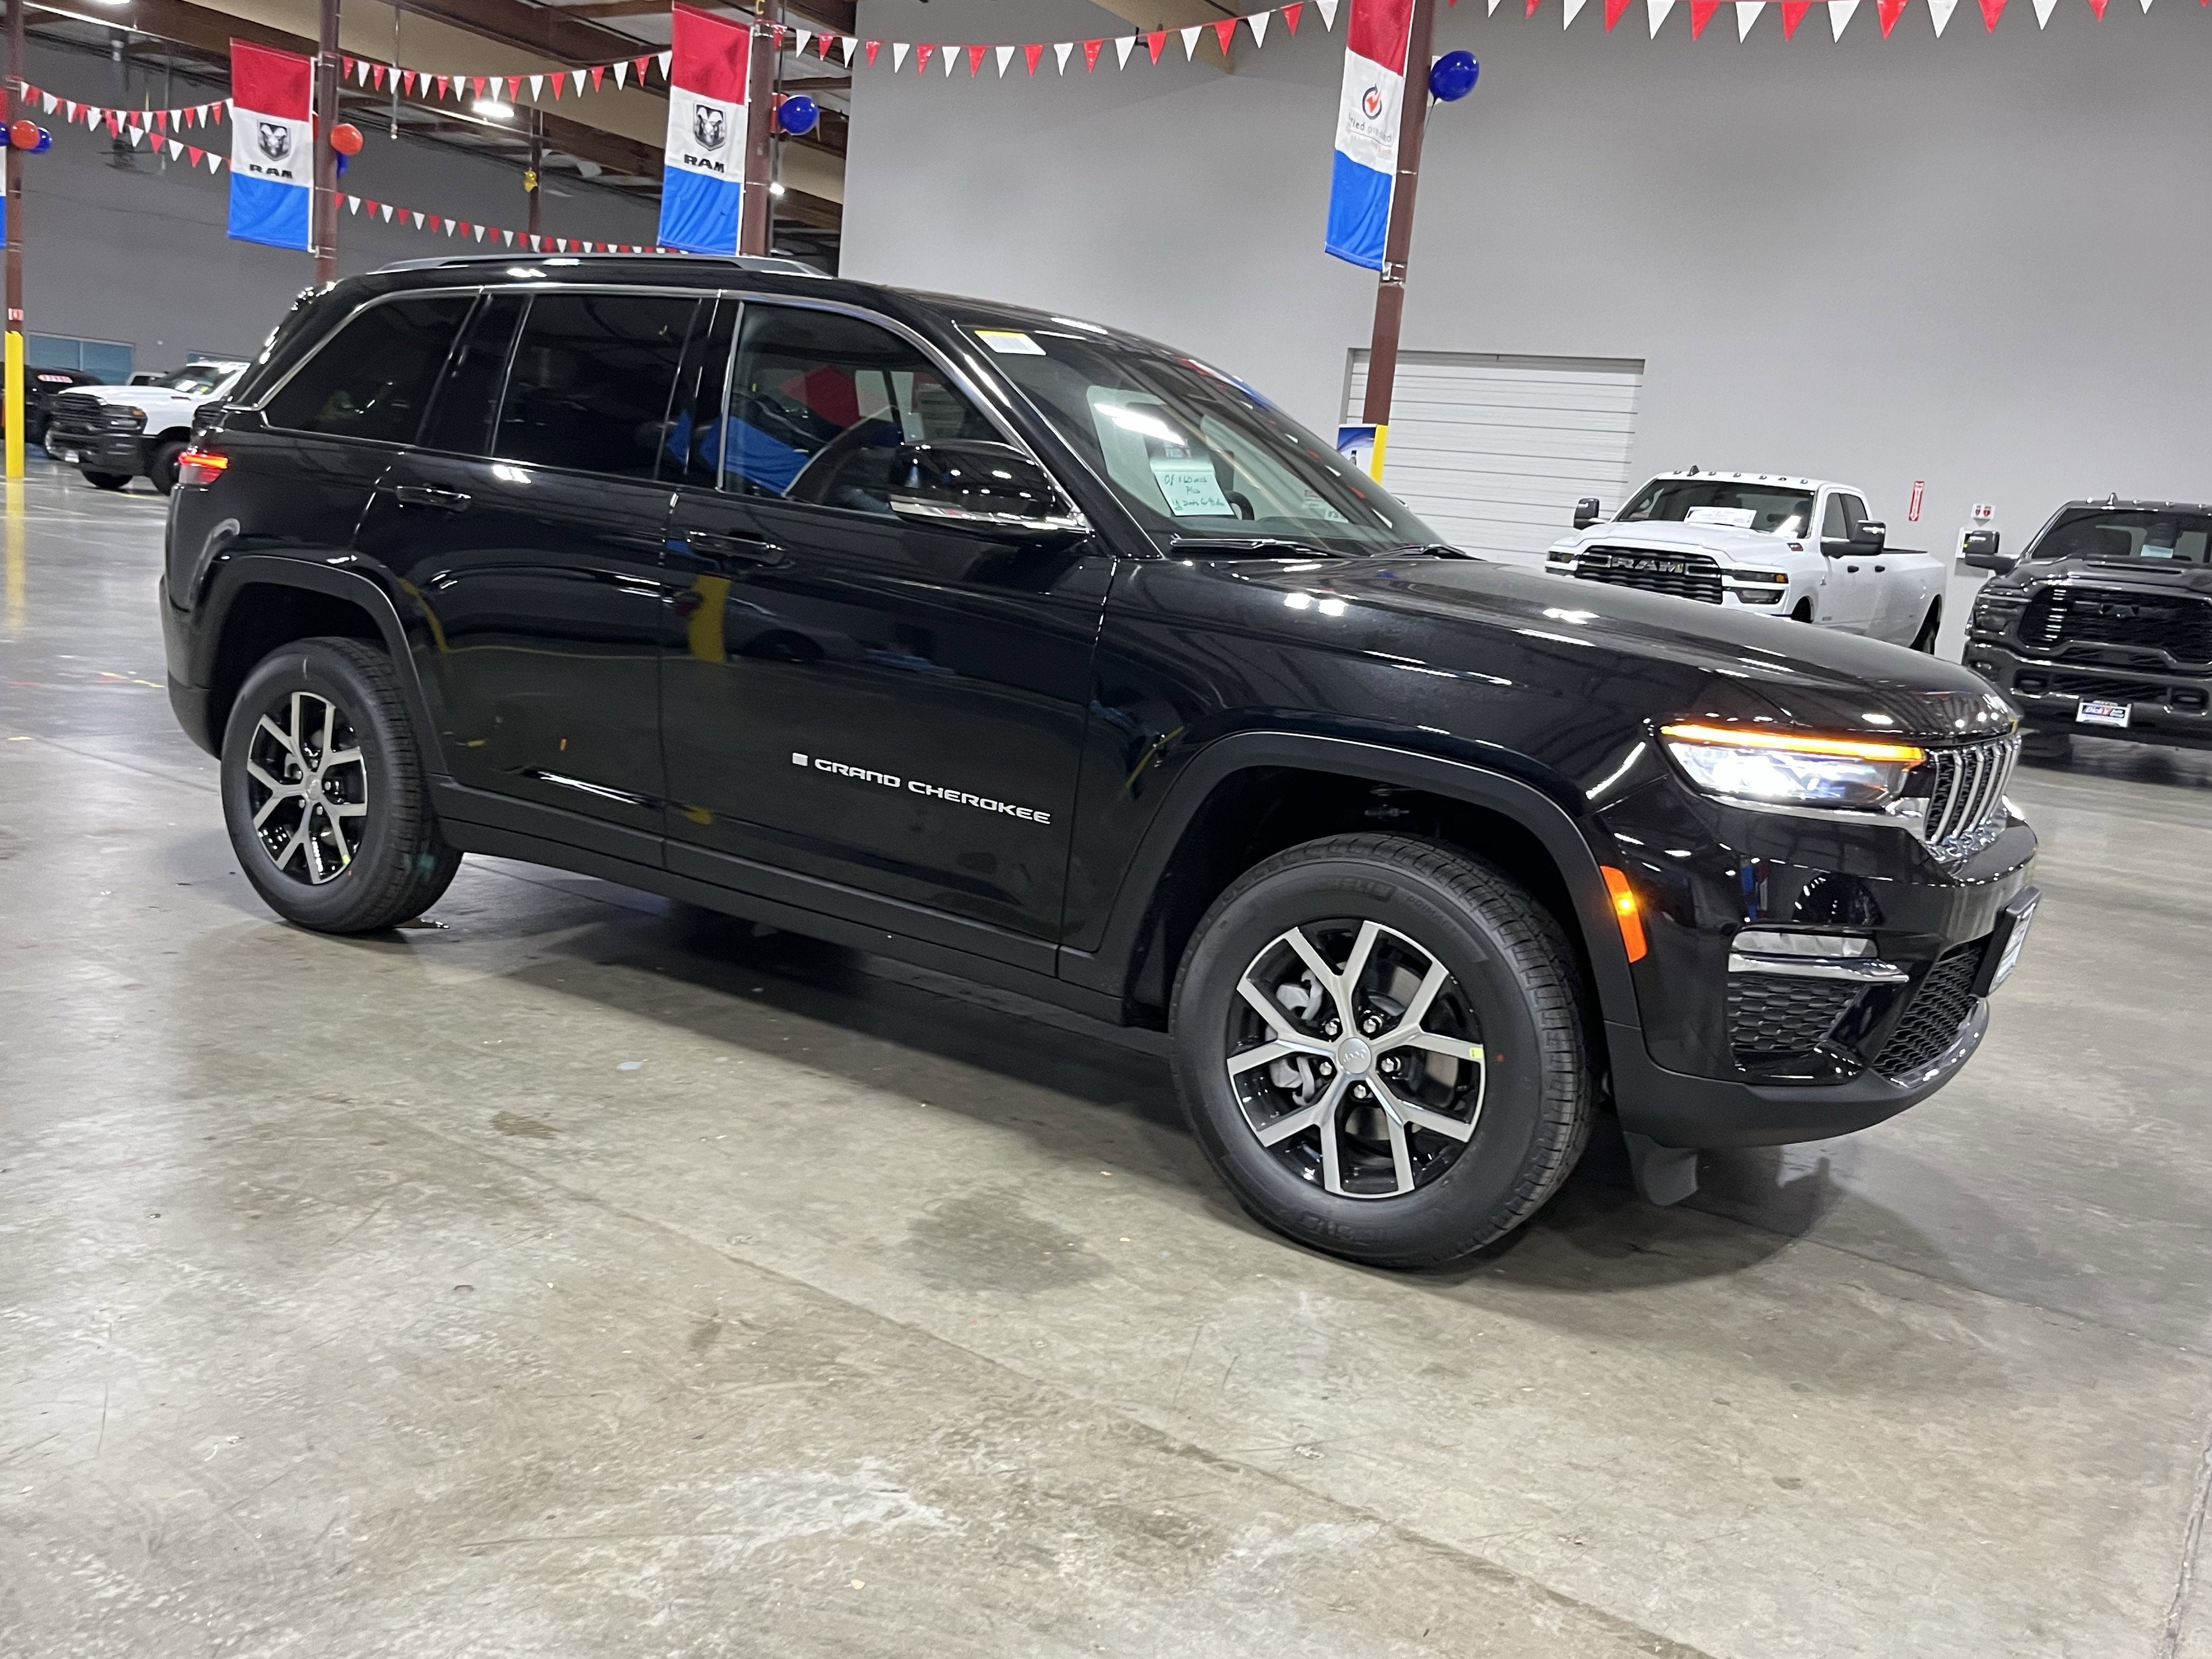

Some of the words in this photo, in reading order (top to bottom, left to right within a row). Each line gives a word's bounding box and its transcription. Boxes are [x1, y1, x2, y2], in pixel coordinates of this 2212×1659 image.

[249, 163, 293, 179] RAM
[684, 154, 724, 173] RAM
[1611, 557, 1684, 573] RAM
[815, 759, 900, 787] GRAND
[908, 781, 1051, 825] CHEROKEE
